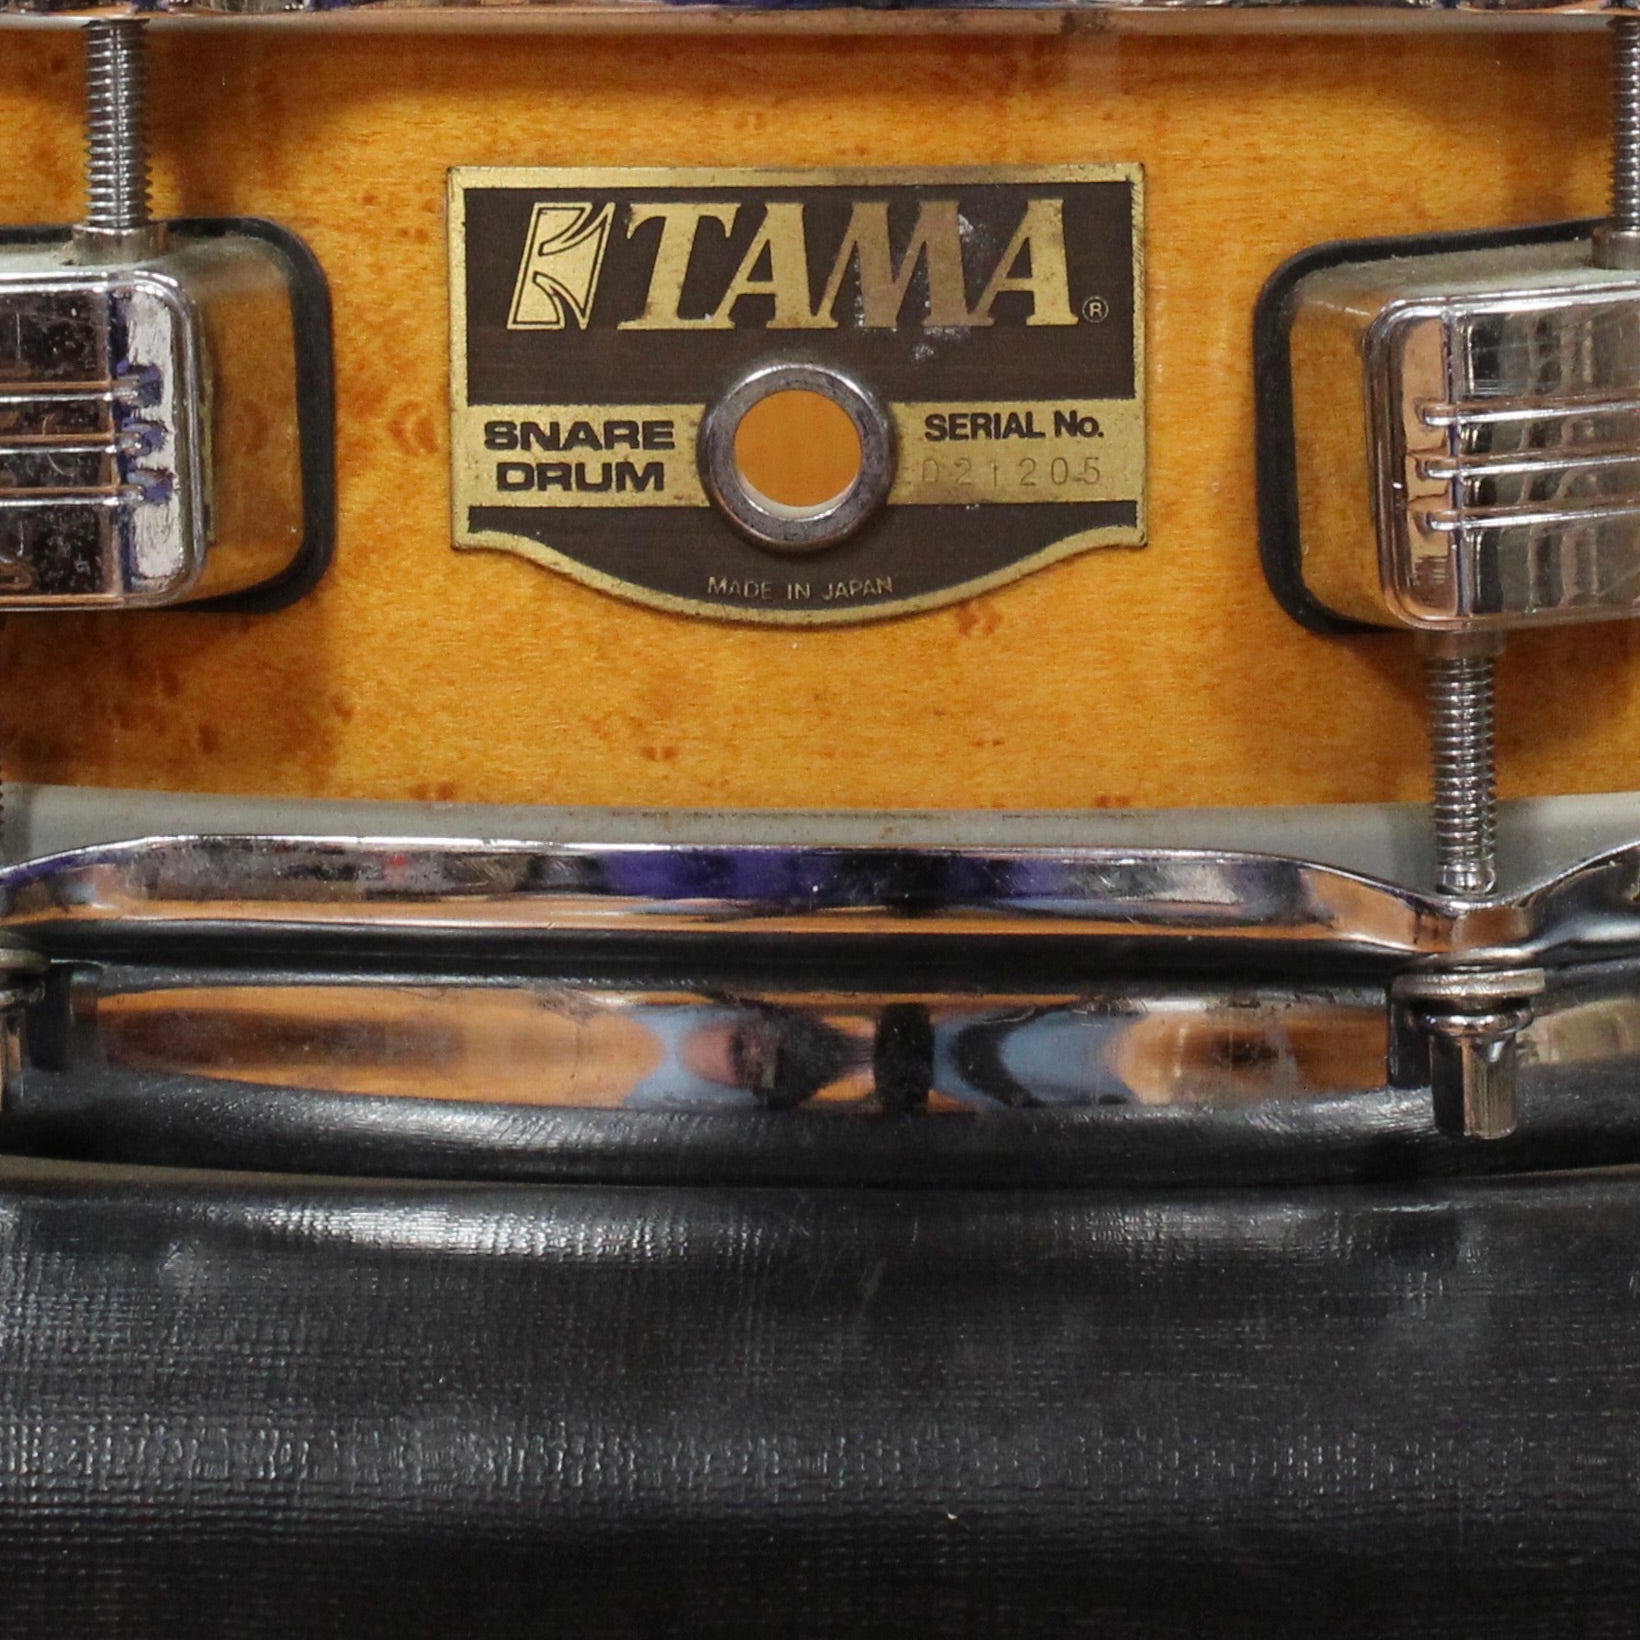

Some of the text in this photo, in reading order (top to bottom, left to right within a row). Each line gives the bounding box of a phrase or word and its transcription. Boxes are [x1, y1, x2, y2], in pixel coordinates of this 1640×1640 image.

[483, 419, 676, 452] SNARE
[923, 409, 1105, 442] SERIAL No.
[496, 461, 665, 493] DRUM
[706, 575, 894, 601] MADE IN JAPAN
